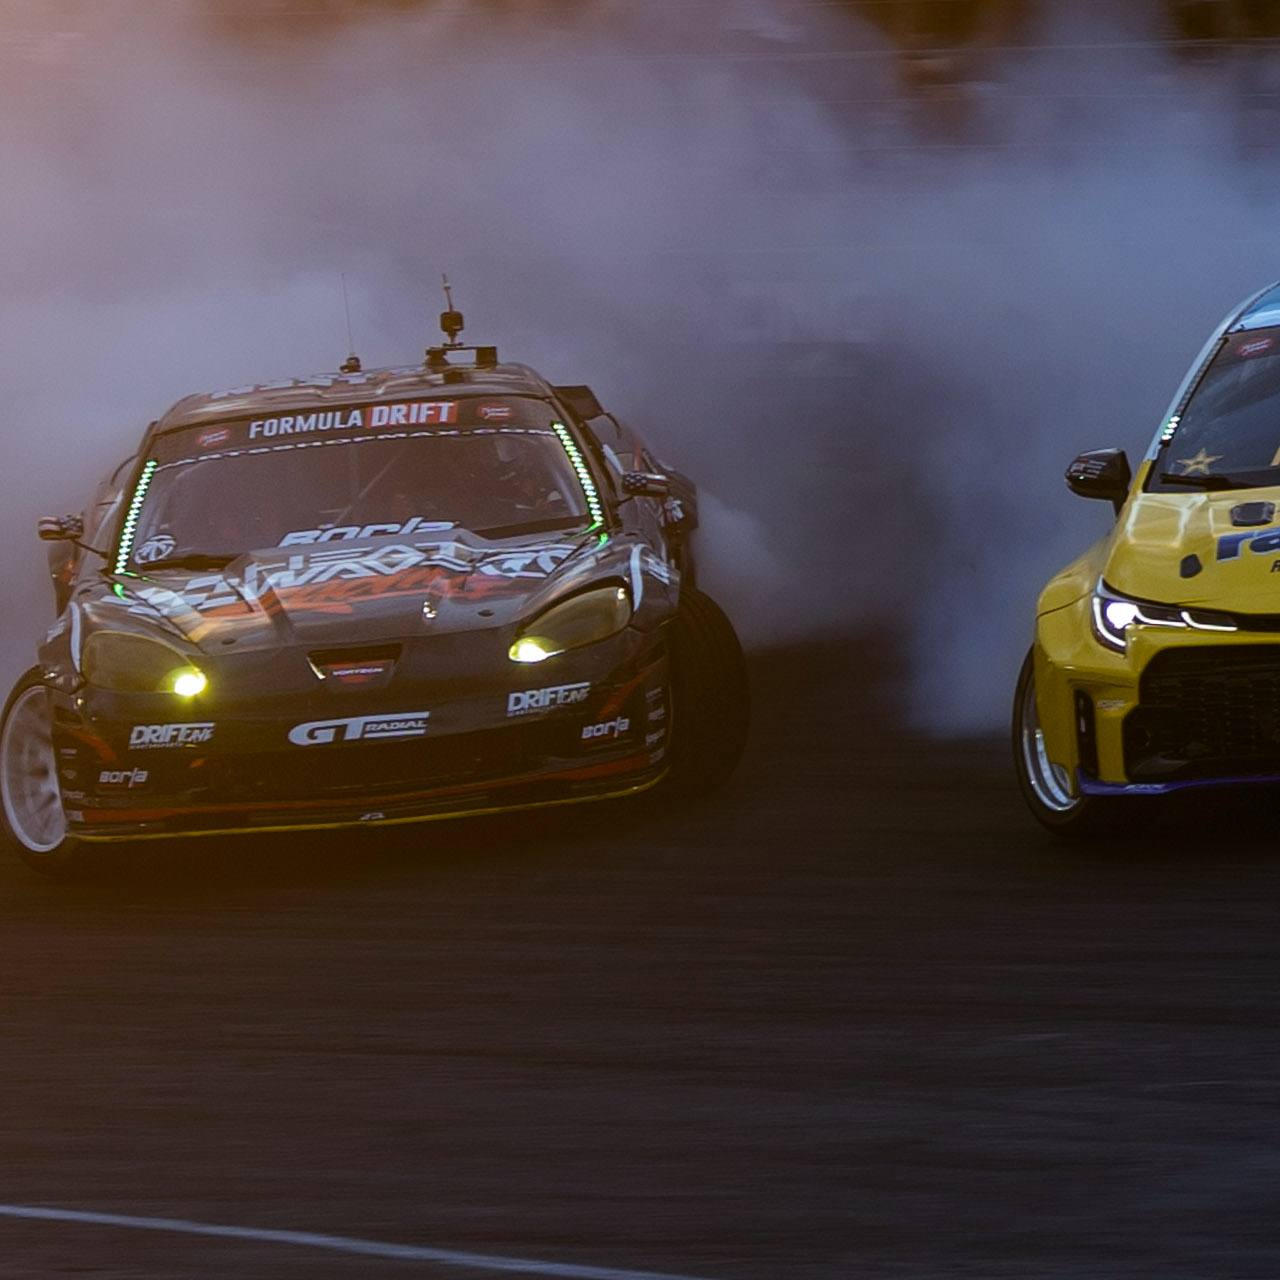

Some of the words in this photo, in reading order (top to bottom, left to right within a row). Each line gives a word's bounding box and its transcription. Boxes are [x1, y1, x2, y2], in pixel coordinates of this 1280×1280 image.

[249, 410, 362, 439] FORMULA
[370, 401, 455, 427] DRIFT
[287, 712, 398, 746] GT
[365, 720, 428, 732] RADIAL
